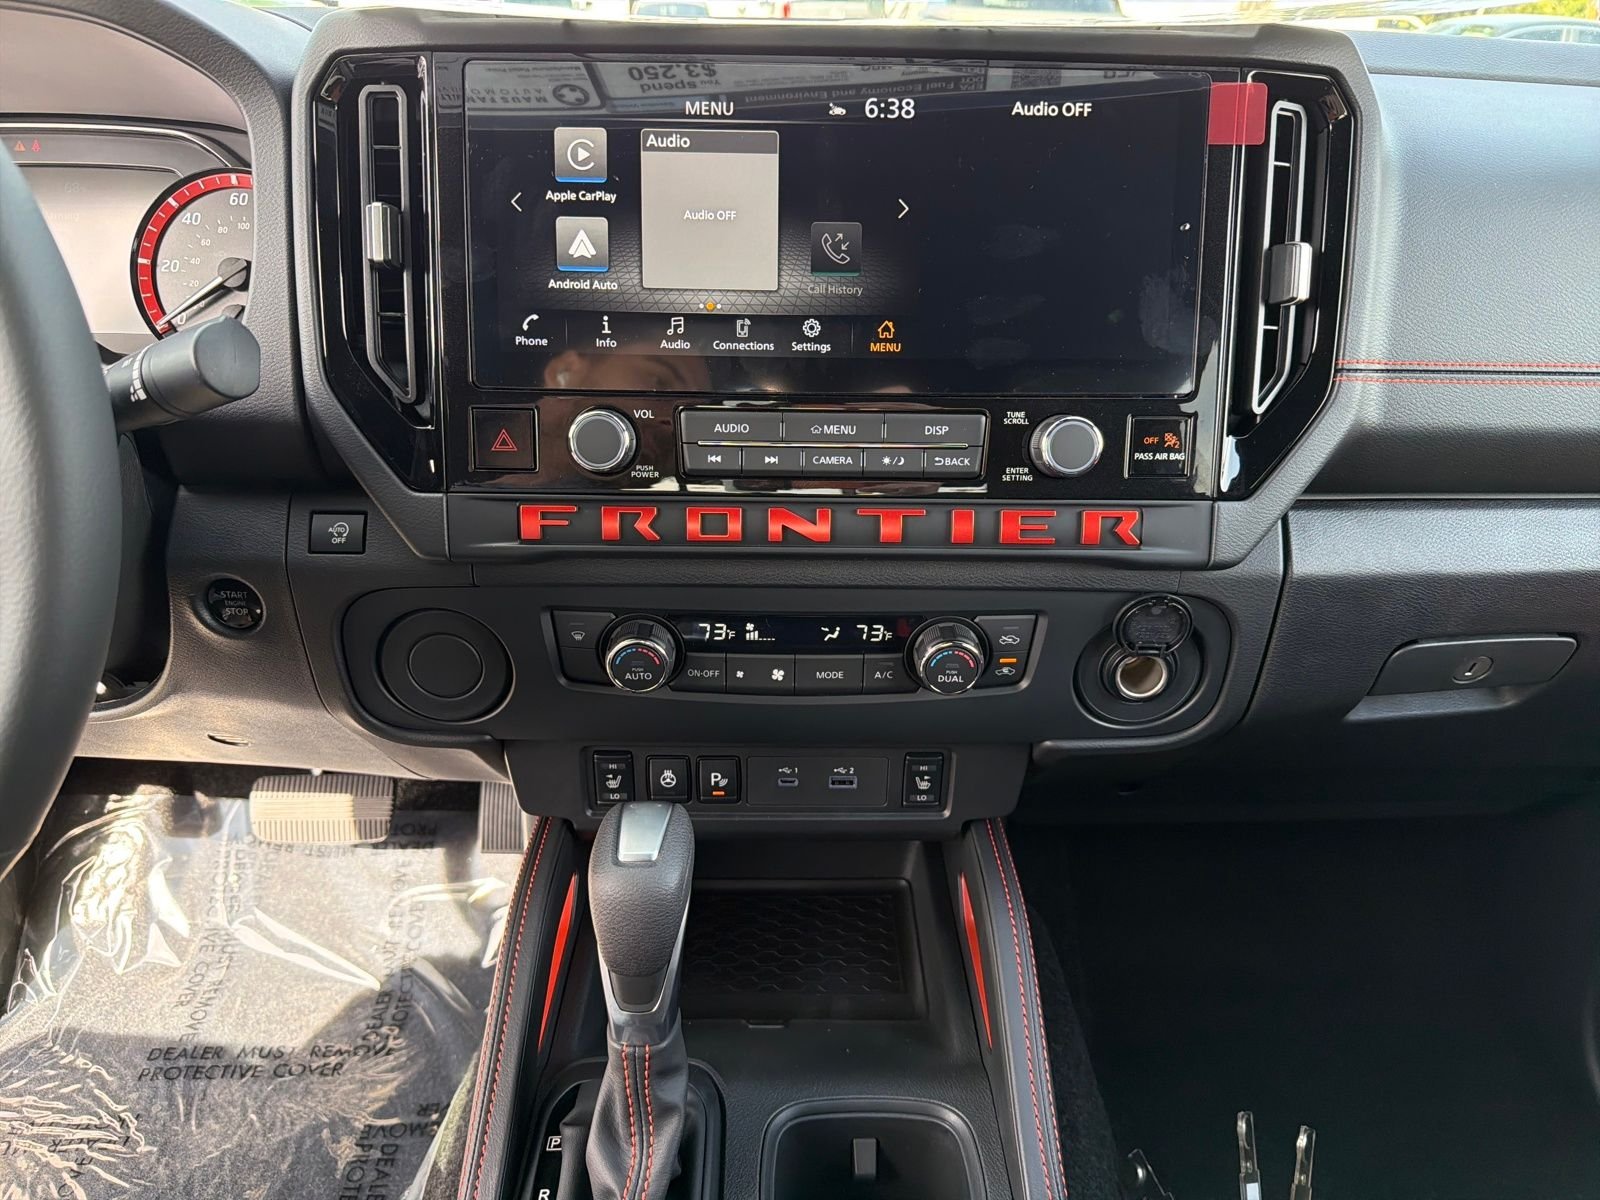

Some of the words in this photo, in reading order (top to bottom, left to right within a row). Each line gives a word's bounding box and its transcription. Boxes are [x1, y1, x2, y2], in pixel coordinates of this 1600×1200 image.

[685, 100, 734, 116] MENU
[864, 97, 916, 119] 6:38
[1011, 101, 1059, 117] Audio
[1062, 102, 1093, 118] OFF
[646, 134, 691, 149] Audio
[229, 192, 249, 206] 60
[545, 189, 577, 203] Apple
[578, 190, 617, 204] CarPlay
[181, 211, 201, 226] 40
[683, 209, 715, 222] Audio
[717, 210, 737, 222] OFF
[237, 222, 250, 230] 100
[161, 259, 180, 273] 20
[190, 257, 201, 265] 40
[548, 278, 591, 291] Android
[593, 279, 619, 291] Auto
[807, 284, 826, 295] Call
[827, 284, 864, 297] History
[177, 311, 187, 325] 0
[515, 335, 549, 347] Phone
[595, 337, 618, 349] Info
[660, 338, 691, 351] Audio
[713, 339, 775, 352] Connections
[791, 341, 832, 354] Settings
[869, 342, 902, 354] MENU
[633, 409, 655, 419] VOL
[1003, 417, 1030, 425] SCROLL
[713, 423, 750, 434] AUDIO
[823, 424, 857, 436] MENU
[924, 424, 950, 436] DISP
[1143, 436, 1159, 445] OFF
[811, 455, 853, 466] CAMERA
[944, 456, 971, 467] BACK
[1134, 451, 1153, 460] PASS
[1154, 451, 1168, 460] AIR
[1169, 452, 1185, 461] BAG
[630, 471, 660, 479] POWER
[1001, 474, 1033, 482] SETTING
[519, 505, 1141, 545] FRONTIER
[331, 537, 347, 545] OFF
[220, 590, 249, 600] START
[225, 607, 249, 616] STOP
[624, 672, 653, 681] AUTO
[816, 671, 845, 680] MODE
[874, 670, 894, 680] A/C
[937, 674, 964, 684] DUAL
[146, 1045, 225, 1062] DEALER
[236, 1044, 297, 1060] MUST
[137, 1063, 264, 1082] PROTECTIVE
[273, 1061, 345, 1079] COVER
[538, 1189, 551, 1200] R
